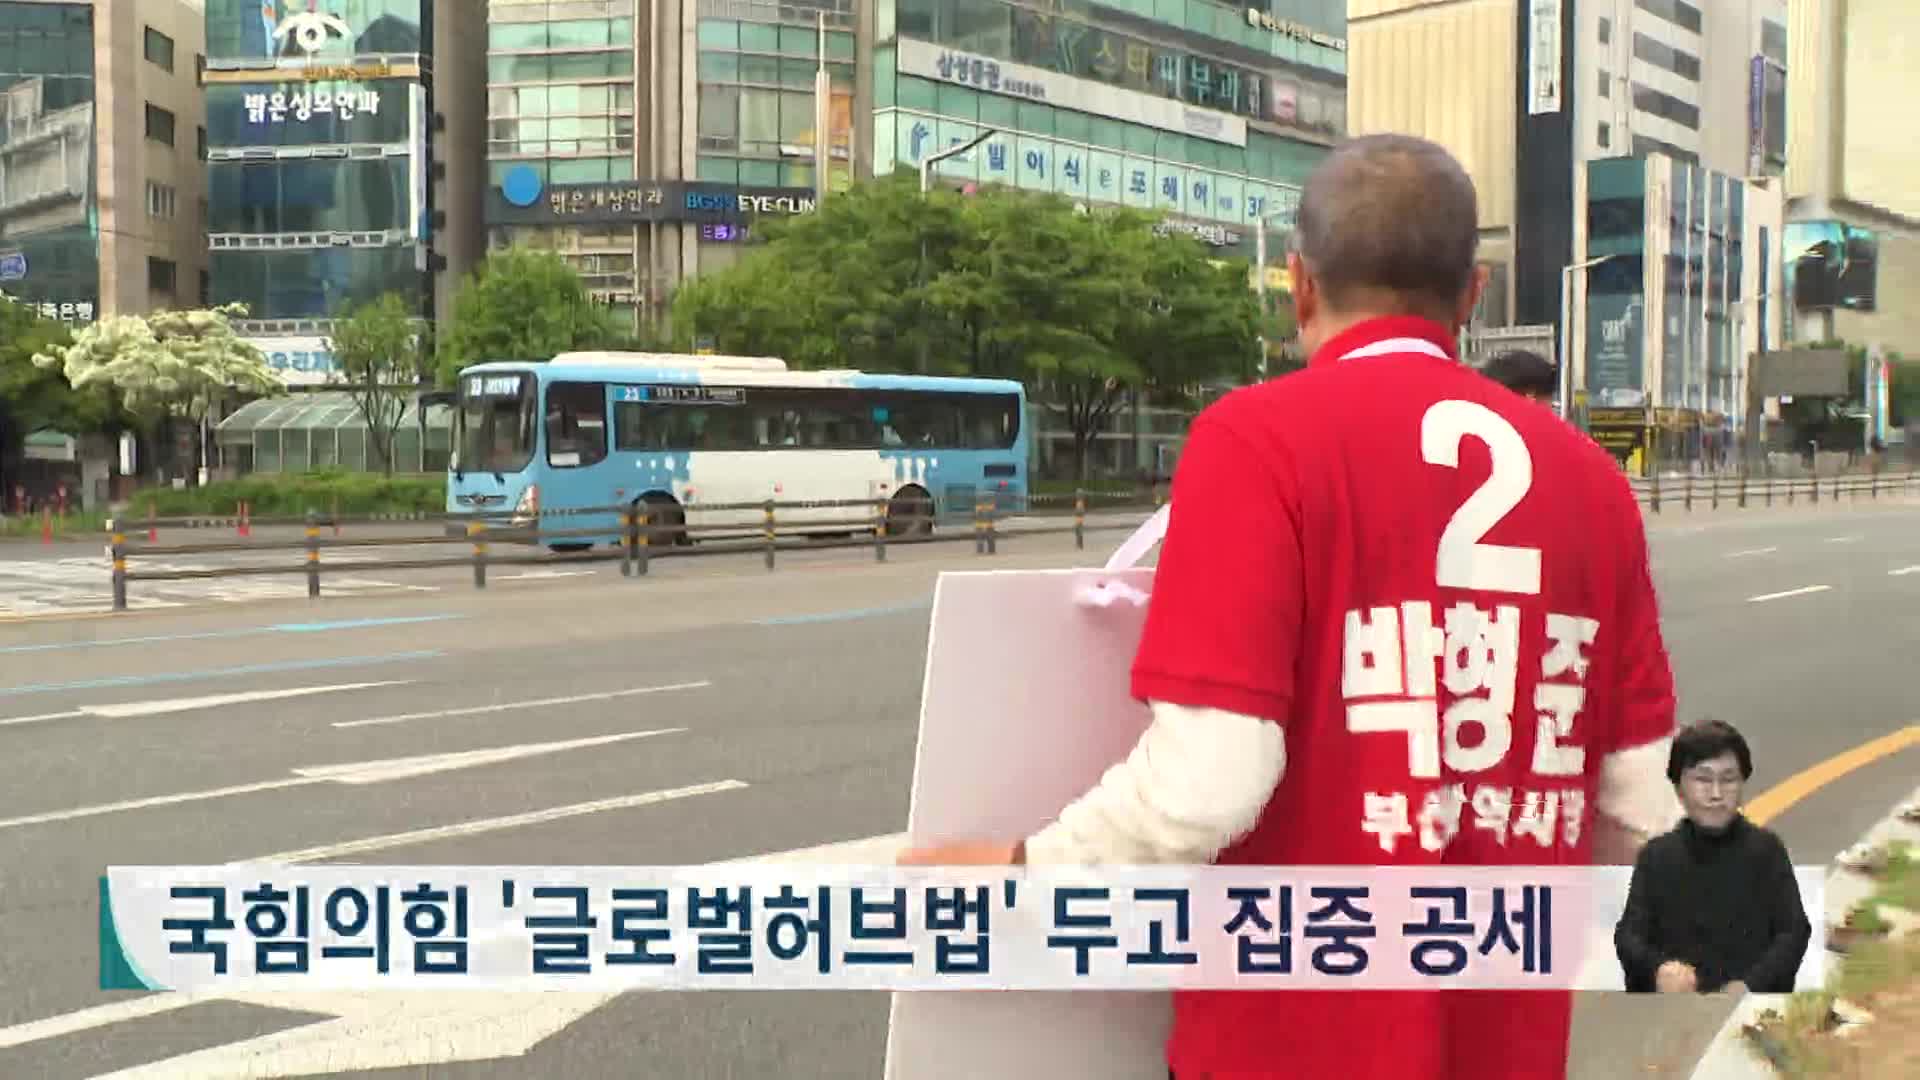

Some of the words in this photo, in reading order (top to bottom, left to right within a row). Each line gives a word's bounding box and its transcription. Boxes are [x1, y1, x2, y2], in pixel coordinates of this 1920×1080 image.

[244, 90, 381, 123] 밝은성모안과
[936, 54, 1001, 91] 삼성증권
[1421, 400, 1542, 595] 2
[1342, 601, 1600, 779] 박형준
